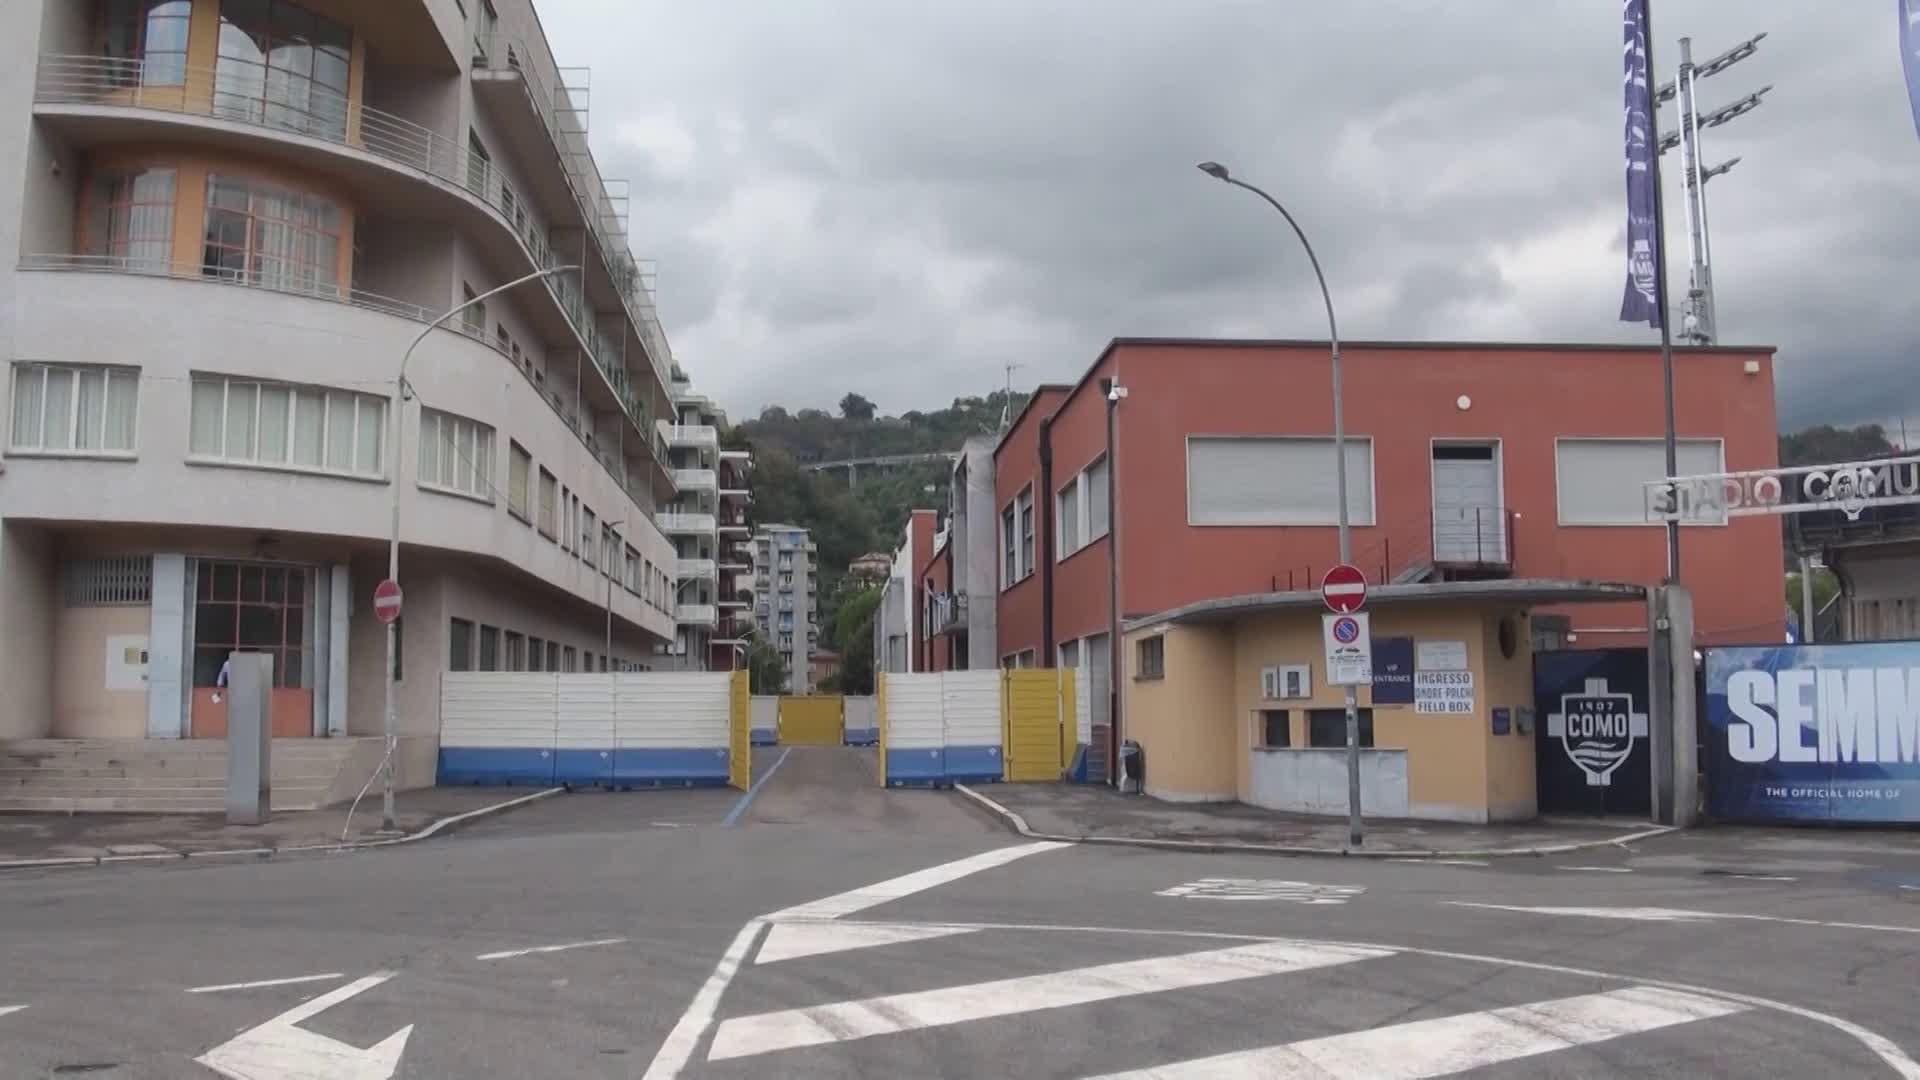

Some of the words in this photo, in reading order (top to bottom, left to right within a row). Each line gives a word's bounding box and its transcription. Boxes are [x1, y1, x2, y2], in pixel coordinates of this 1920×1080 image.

[1374, 675, 1411, 683] ENTRANCE
[1417, 672, 1470, 685] INGRESSO
[1417, 702, 1446, 712] FIELD
[1448, 701, 1472, 712] BOX
[1568, 713, 1627, 737] COMO
[1765, 787, 1787, 797] THE
[1791, 788, 1843, 798] OFFICIAL
[1847, 789, 1881, 798] HOME
